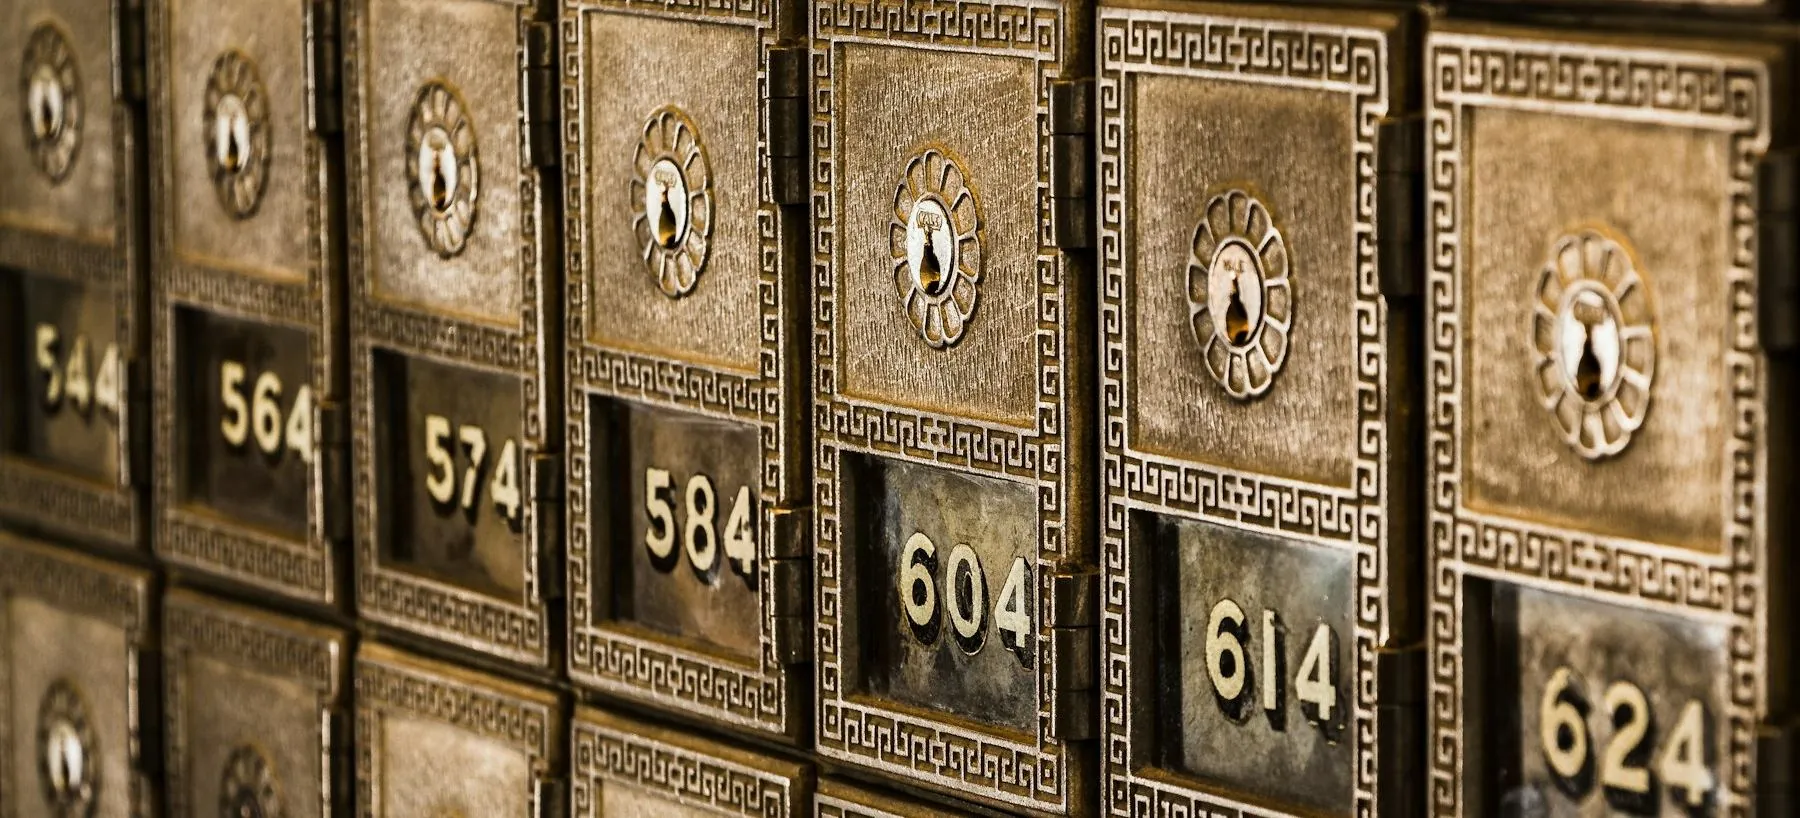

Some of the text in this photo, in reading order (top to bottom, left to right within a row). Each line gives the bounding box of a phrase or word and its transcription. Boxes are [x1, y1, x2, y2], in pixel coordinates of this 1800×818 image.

[220, 361, 314, 464] 564
[425, 414, 520, 518] 574
[644, 467, 756, 573] 584
[902, 531, 1032, 648] 604
[1205, 599, 1336, 721] 614
[1540, 667, 1712, 805] 624
